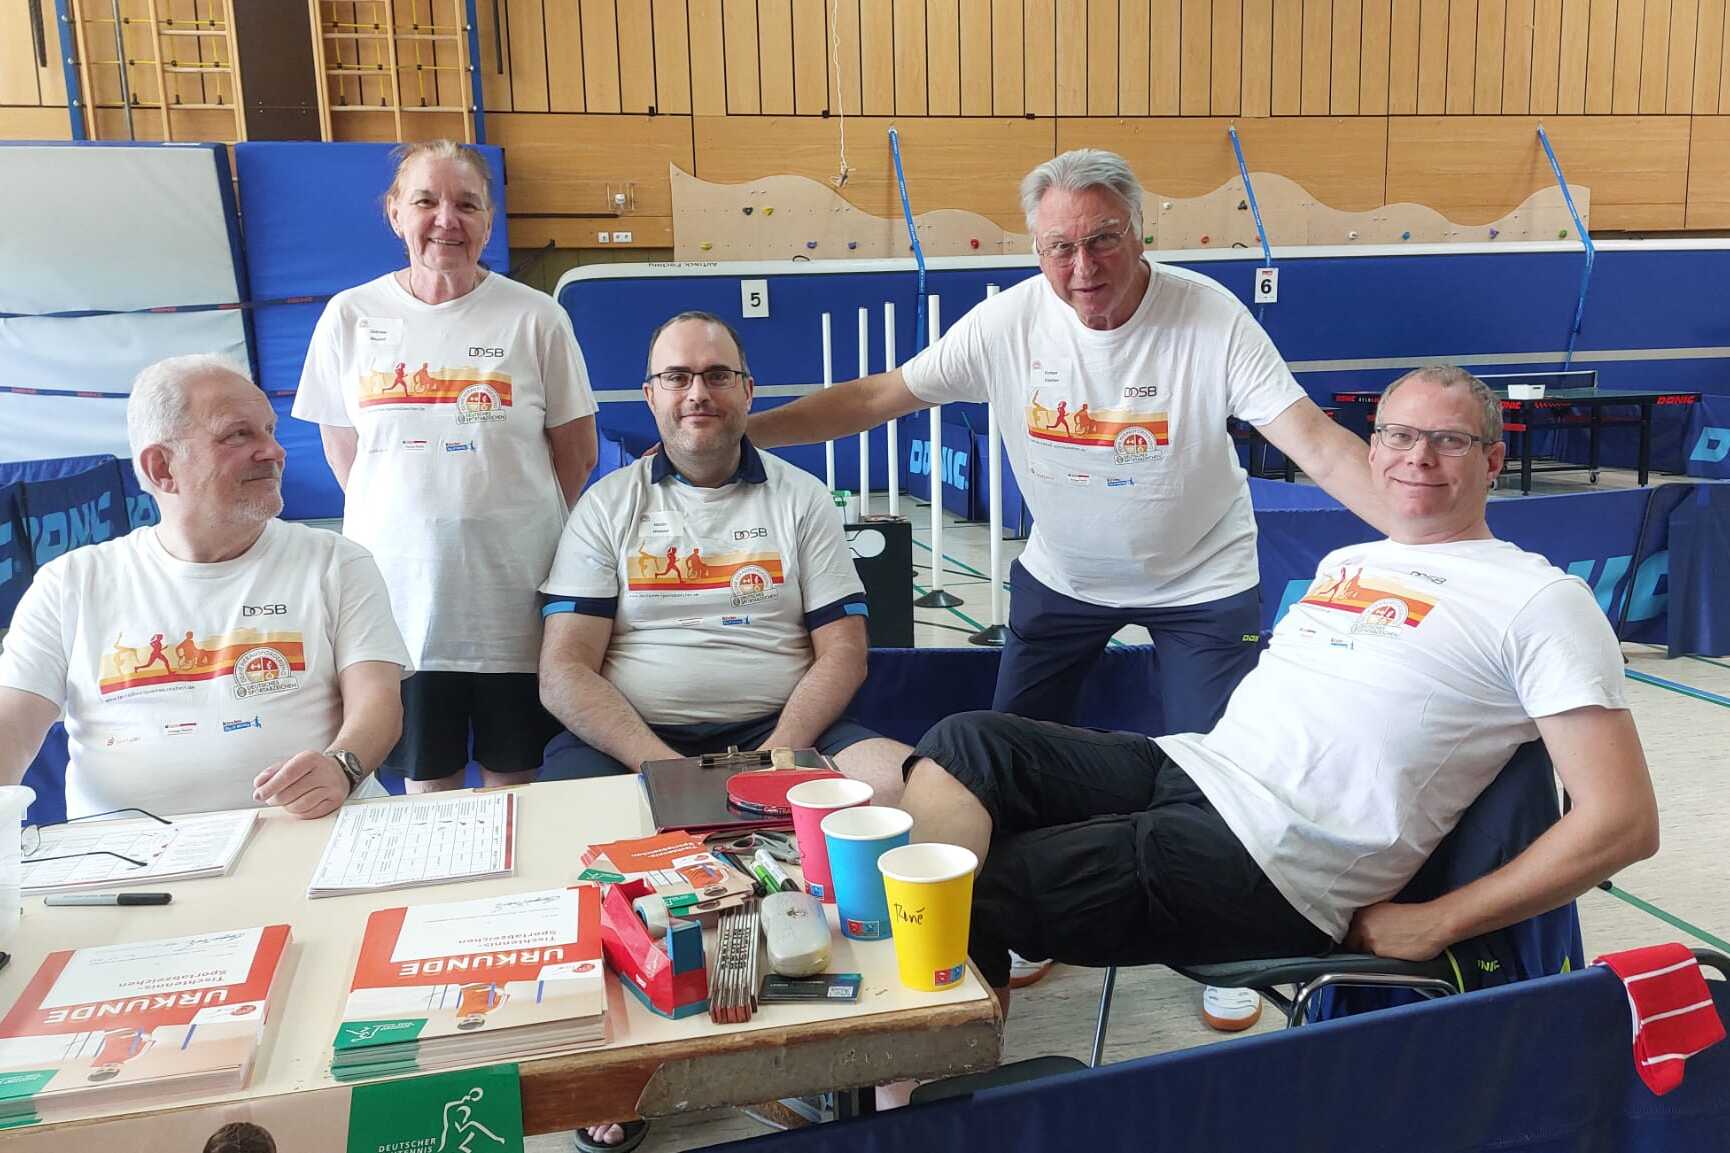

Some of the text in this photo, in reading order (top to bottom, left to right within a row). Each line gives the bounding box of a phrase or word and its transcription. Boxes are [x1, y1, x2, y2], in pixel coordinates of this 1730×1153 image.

[1260, 278, 1272, 295] 6
[750, 292, 761, 308] 5
[469, 346, 505, 358] DOSB
[1123, 385, 1157, 398] DOSB
[1656, 395, 1698, 405] DONIC
[734, 527, 768, 541] DOSB
[242, 604, 288, 617] DOSB
[399, 948, 564, 976] URKUNDE
[43, 989, 229, 1024] URKUNDE
[378, 1137, 437, 1153] DEUTSCHER
